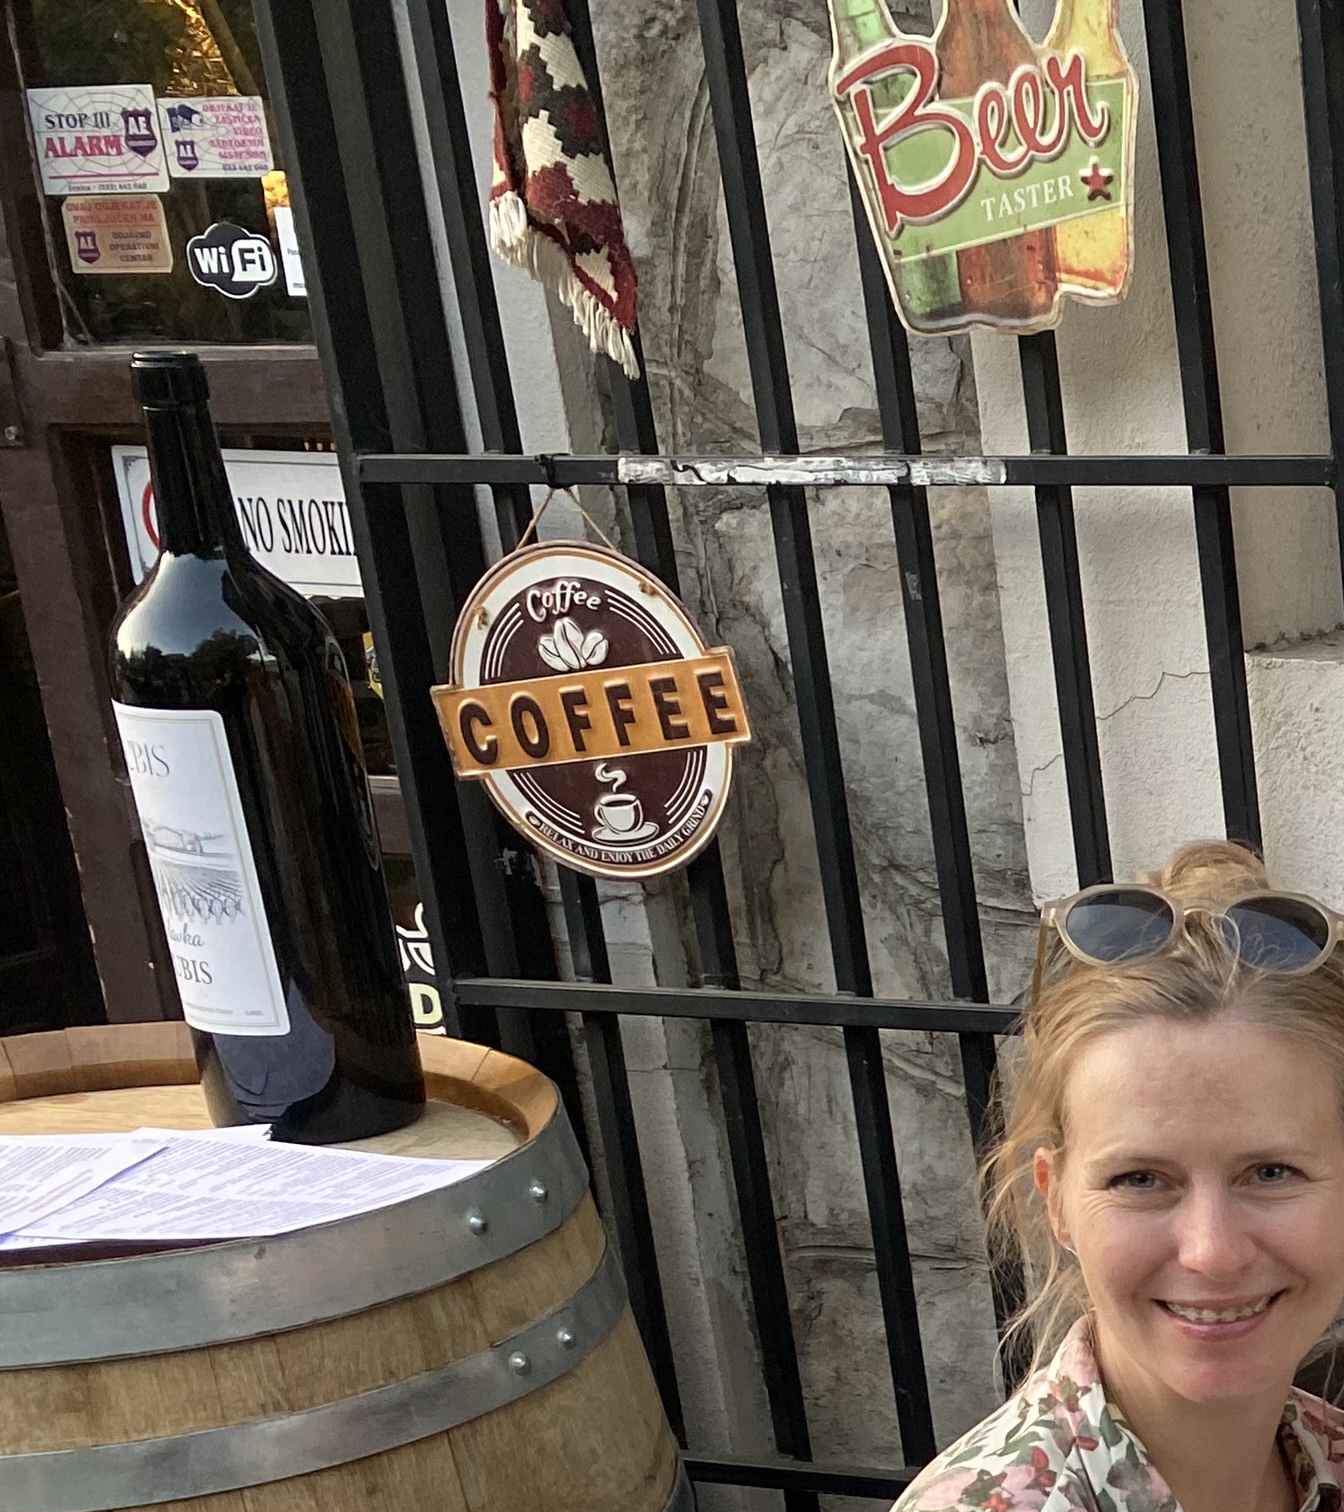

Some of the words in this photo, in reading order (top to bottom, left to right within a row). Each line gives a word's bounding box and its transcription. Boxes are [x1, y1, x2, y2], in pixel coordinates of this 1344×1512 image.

[44, 134, 124, 158] ALARM
[45, 112, 87, 130] STOP
[836, 44, 1110, 234] Beer
[980, 174, 1075, 222] TASTER
[237, 496, 274, 553] NO
[276, 498, 357, 556] SMOKI
[526, 580, 602, 623] Coffee
[458, 669, 738, 766] COFFEE
[539, 821, 573, 849] RELAX
[574, 844, 599, 861] AND
[601, 850, 634, 863] ENJOY
[636, 848, 658, 861] THE
[656, 831, 685, 856] DAILY
[682, 804, 707, 838] GRIND
